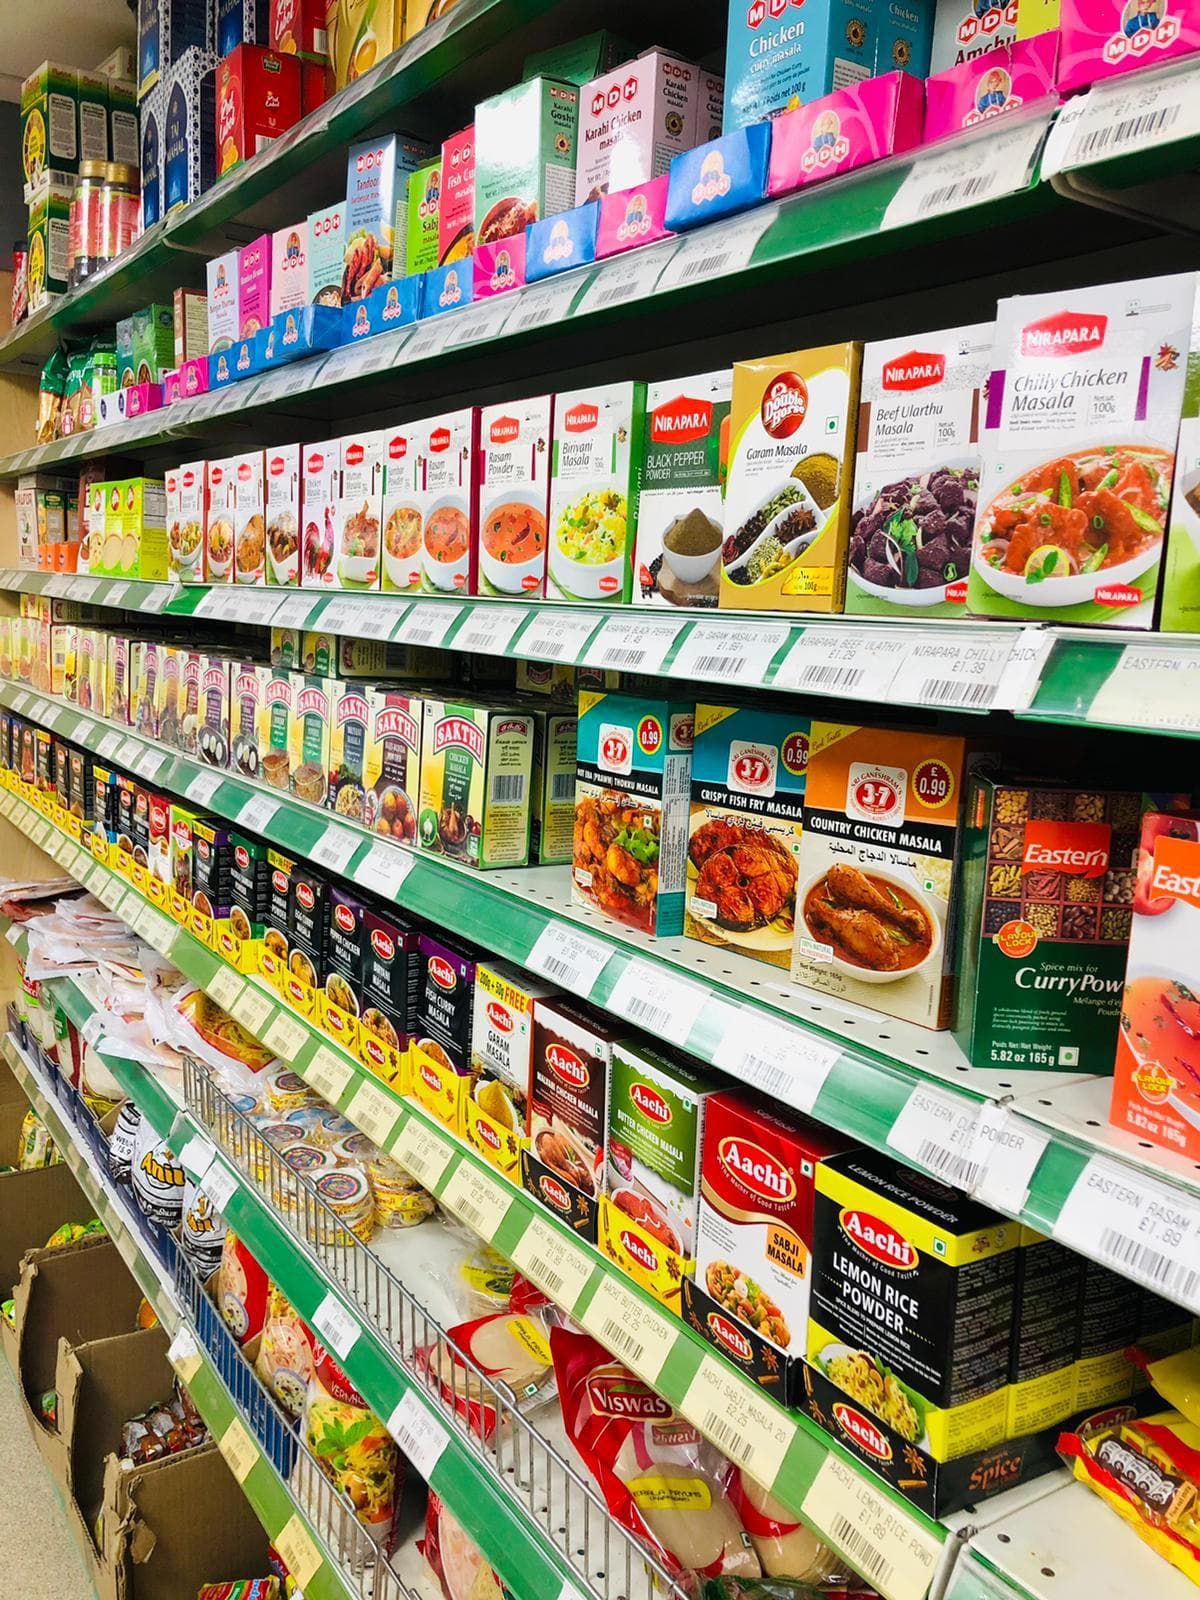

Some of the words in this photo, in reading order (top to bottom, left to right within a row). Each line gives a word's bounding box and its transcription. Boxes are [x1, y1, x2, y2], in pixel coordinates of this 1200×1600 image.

[889, 3, 919, 23] Chicken
[750, 21, 805, 57] Chicken
[1107, 22, 1176, 60] MDH
[773, 43, 802, 65] masala
[664, 63, 692, 81] MDH
[549, 88, 577, 103] MDH
[663, 88, 688, 103] Chicken
[665, 79, 687, 92] Karahi
[554, 102, 573, 114] Karahi
[592, 80, 638, 115] MDH
[551, 111, 575, 124] Gosht
[585, 121, 610, 143] Karahi
[356, 151, 384, 174] MDH
[804, 141, 852, 170] MDH
[448, 174, 462, 190] Fish
[314, 214, 341, 236] MDH
[619, 220, 651, 239] MDH
[282, 255, 305, 271] MDH
[491, 272, 516, 289] MDH
[1026, 325, 1101, 347] NIRAPARA
[885, 365, 942, 383] NIRAPARA
[1014, 373, 1059, 394] Chilly
[1060, 368, 1128, 390] Chicken
[764, 389, 804, 424] Double
[876, 406, 901, 422] Beef
[901, 402, 943, 417] Ularthu
[1011, 391, 1075, 413] Masala
[1092, 402, 1117, 414] 100g
[565, 413, 598, 428] NIRAPARA
[654, 410, 708, 432] NIRAPARA
[770, 404, 805, 432] Horse
[490, 424, 519, 439] NIRAPARA
[875, 422, 914, 437] Masala
[937, 426, 956, 438] 100g
[488, 451, 513, 464] Rasam
[561, 441, 594, 457] Biriyani
[647, 453, 673, 469] BLACK
[673, 450, 705, 467] PEPPER
[746, 446, 774, 461] Garam
[774, 443, 808, 457] Masala
[488, 464, 515, 476] Powder
[561, 454, 590, 468] Masala
[645, 468, 671, 481] POWDER
[804, 580, 818, 592] 100g
[1096, 589, 1140, 602] NIRAPARA
[731, 631, 757, 643] MASALA
[800, 636, 838, 648] NIRAPARA
[840, 638, 863, 650] BEEF
[828, 649, 856, 661] £1.29
[912, 645, 961, 659] NIRAPARA
[1007, 648, 1040, 662] CHICK
[1122, 656, 1181, 671] EASTERN
[952, 661, 985, 675] £1.39
[377, 710, 417, 748] SAKTHI
[436, 718, 483, 758] SAKTHI
[640, 730, 659, 745] 0.99
[786, 748, 808, 765] 0.99
[930, 766, 938, 777] £
[613, 776, 635, 791] THOKKU
[634, 779, 659, 795] MASALA
[918, 778, 946, 797] 0.99
[700, 788, 726, 803] CRISPY
[728, 793, 748, 809] FISH
[748, 797, 766, 812] FRY
[765, 801, 803, 819] MASALA
[810, 816, 852, 835] COUNTRY
[853, 825, 897, 844] CHICKEN
[898, 833, 943, 854] MASALA
[1024, 844, 1108, 867] Eastern
[296, 886, 314, 906] Aachi
[336, 908, 355, 928] Aachi
[371, 933, 395, 955] Aachi
[429, 961, 457, 986] Aachi
[1040, 962, 1066, 973] Spice
[1066, 963, 1084, 973] mix
[1085, 963, 1099, 974] for
[372, 974, 391, 997] MASALA
[1014, 967, 1125, 997] CurryPow
[424, 986, 439, 1004] FISH
[438, 995, 456, 1016] CURRY
[504, 986, 526, 1013] FREE
[1073, 997, 1107, 1008] Mélange
[327, 1009, 344, 1030] Aachi
[427, 1004, 451, 1027] MASALA
[487, 1006, 515, 1031] Aachi
[487, 1030, 511, 1051] GARAM
[366, 1042, 386, 1063] Aachi
[486, 1043, 511, 1070] MASALA
[991, 1050, 1013, 1063] 5.82
[1014, 1053, 1026, 1063] oz
[1029, 1051, 1048, 1064] 165
[548, 1047, 586, 1084] Aachi
[420, 1067, 442, 1090] Aachi
[576, 1096, 599, 1119] MASALA
[632, 1085, 670, 1121] Aachi
[910, 1092, 954, 1123] EASTERN
[980, 1124, 1024, 1150] POWDER
[476, 1125, 501, 1149] Aachi
[617, 1108, 635, 1129] BUTTER
[636, 1121, 660, 1145] CHICKEN
[660, 1138, 684, 1162] MASALA
[140, 1150, 186, 1187] Anil
[725, 1142, 789, 1197] Aachi
[541, 1178, 571, 1206] Aachi
[847, 1163, 885, 1187] LEMON
[883, 1182, 908, 1201] RICE
[906, 1194, 958, 1225] POWDER
[1087, 1172, 1145, 1209] EASTERN
[1146, 1201, 1192, 1232] RASAM
[846, 1211, 911, 1266] Aachi
[1136, 1215, 1184, 1248] £1.89
[622, 1231, 657, 1269] Aachi
[773, 1233, 799, 1257] SABJI
[767, 1244, 804, 1276] MASALA
[832, 1250, 882, 1297] LEMON
[884, 1283, 919, 1320] RICE
[602, 1281, 622, 1301] AACHI
[621, 1293, 644, 1321] BUTTER
[642, 1312, 669, 1341] CHICKEN
[842, 1280, 904, 1335] POWDER
[622, 1311, 642, 1332] £2.25
[710, 1315, 752, 1357] Aachi
[591, 1386, 668, 1414] Viswas
[701, 1368, 726, 1391] AACHI
[724, 1384, 747, 1411] SABJI
[748, 1405, 774, 1435] MASALA
[774, 1428, 788, 1445] 20
[724, 1405, 748, 1429] £2.25
[839, 1407, 889, 1457] Aachi
[968, 1455, 1023, 1491] Spice
[828, 1460, 856, 1491] AACHI
[855, 1487, 884, 1518] LEMON
[883, 1513, 907, 1543] RICE
[909, 1540, 933, 1568] POWD
[857, 1511, 887, 1541] £1.89
